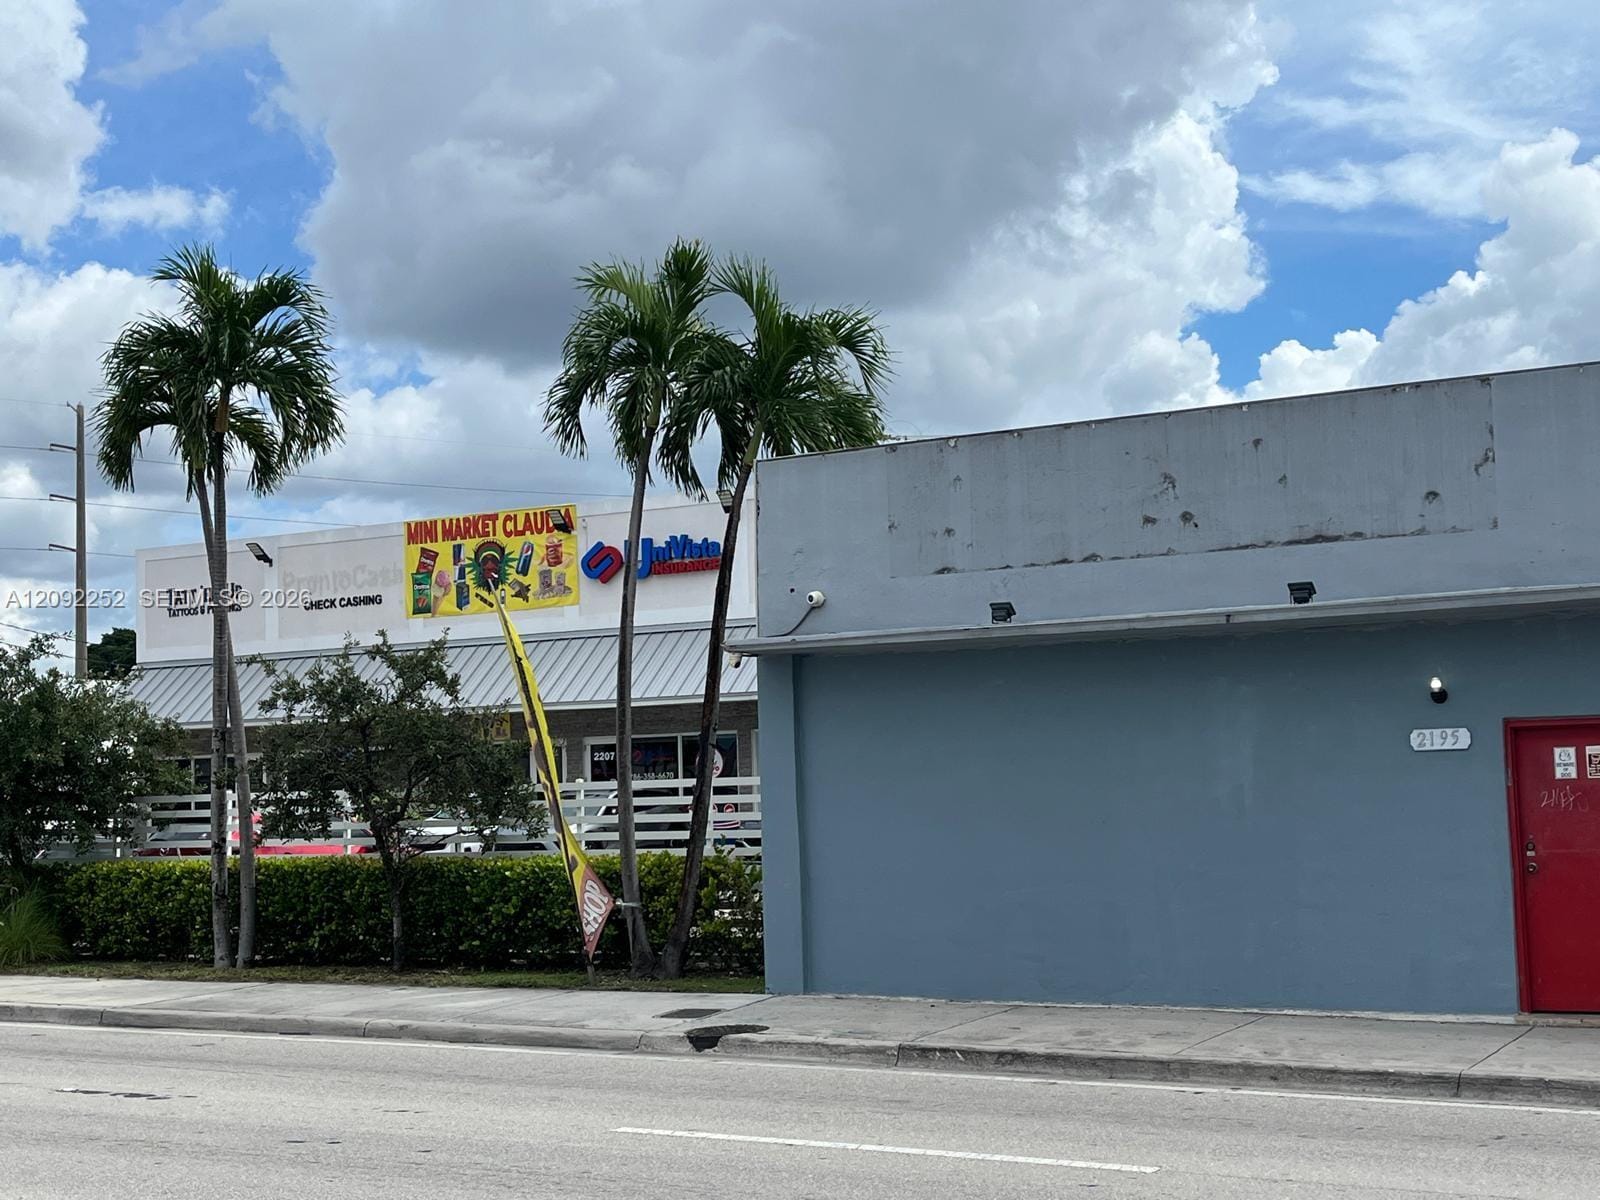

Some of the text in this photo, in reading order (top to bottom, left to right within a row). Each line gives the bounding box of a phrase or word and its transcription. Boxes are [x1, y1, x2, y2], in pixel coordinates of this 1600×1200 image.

[407, 508, 574, 545] MINI MARKET CLAUDA
[652, 558, 720, 575] INSURANCE
[304, 595, 383, 611] CHECK CASHING
[167, 607, 198, 618] TATTOOS
[1416, 729, 1460, 748] 2195
[593, 752, 615, 761] 2207
